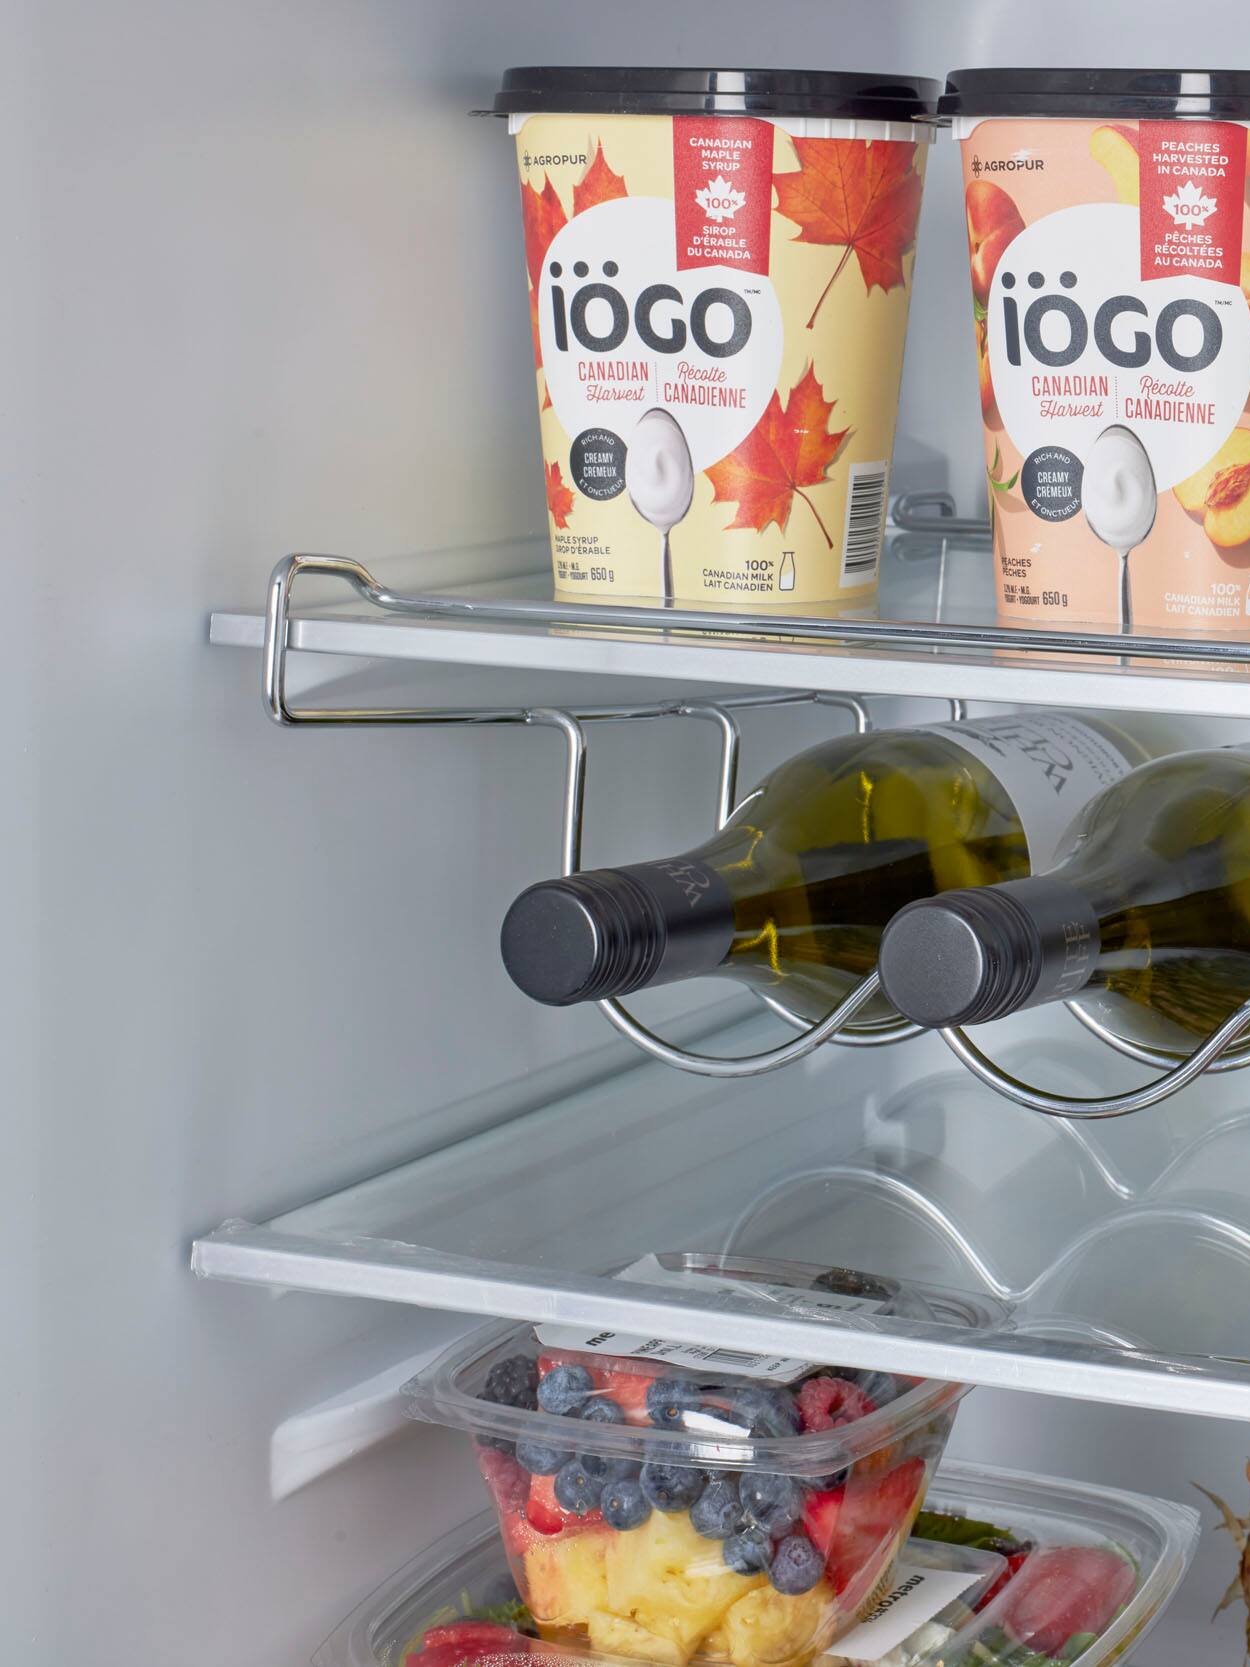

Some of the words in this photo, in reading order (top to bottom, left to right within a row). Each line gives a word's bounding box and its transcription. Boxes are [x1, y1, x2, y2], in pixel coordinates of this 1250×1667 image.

[690, 138, 751, 148] CANADIAN
[1161, 141, 1220, 153] PEACHES
[533, 154, 587, 166] AGROPUR
[702, 149, 740, 160] MAPLE
[1153, 153, 1229, 165] HARVESTED
[702, 161, 740, 171] SYRUP
[984, 158, 1044, 172] AGROPUR
[1158, 165, 1170, 175] IN
[1173, 166, 1225, 177] CANADA
[705, 198, 738, 209] 100%
[1173, 204, 1208, 216] 100%
[703, 226, 735, 235] SIROP
[693, 236, 746, 247] D'ÉRABLE
[1165, 231, 1212, 244] PÊCHES
[687, 248, 701, 256] DU
[704, 249, 750, 259] CANADA
[1155, 243, 1223, 257] RÉCOLTÉES
[1154, 257, 1170, 266] AU
[1173, 258, 1223, 268] CANADA
[578, 361, 649, 382] CANADIAN
[677, 362, 727, 383] Récolte
[1031, 375, 1109, 397] CANADIAN
[1139, 375, 1195, 398] Récolte
[586, 385, 645, 402] Harvest
[664, 383, 746, 408] CANADIENNE
[1039, 400, 1104, 418] Harvest
[1125, 397, 1216, 425] CANADIENNE
[581, 435, 597, 445] RICH
[599, 434, 615, 445] AND
[584, 452, 613, 463] CREAMY
[1034, 452, 1051, 464] RICH
[1054, 453, 1070, 464] AND
[1037, 472, 1069, 483] CREAMY
[1041, 498, 1080, 517] ONCTUEUX
[573, 536, 598, 544] SYRUP
[745, 560, 774, 571] 100%
[1001, 557, 1031, 567] PEACHES
[591, 567, 606, 580] 650
[703, 569, 748, 580] CANADIAN
[751, 573, 774, 581] MILK
[704, 580, 722, 588] LAIT
[724, 581, 773, 591] CANADIEN
[1042, 591, 1060, 605] 650
[1165, 592, 1214, 605] CANADIAN
[1217, 597, 1240, 606] MILK
[1166, 603, 1185, 613] LAIT
[1188, 605, 1240, 616] CANADIEN
